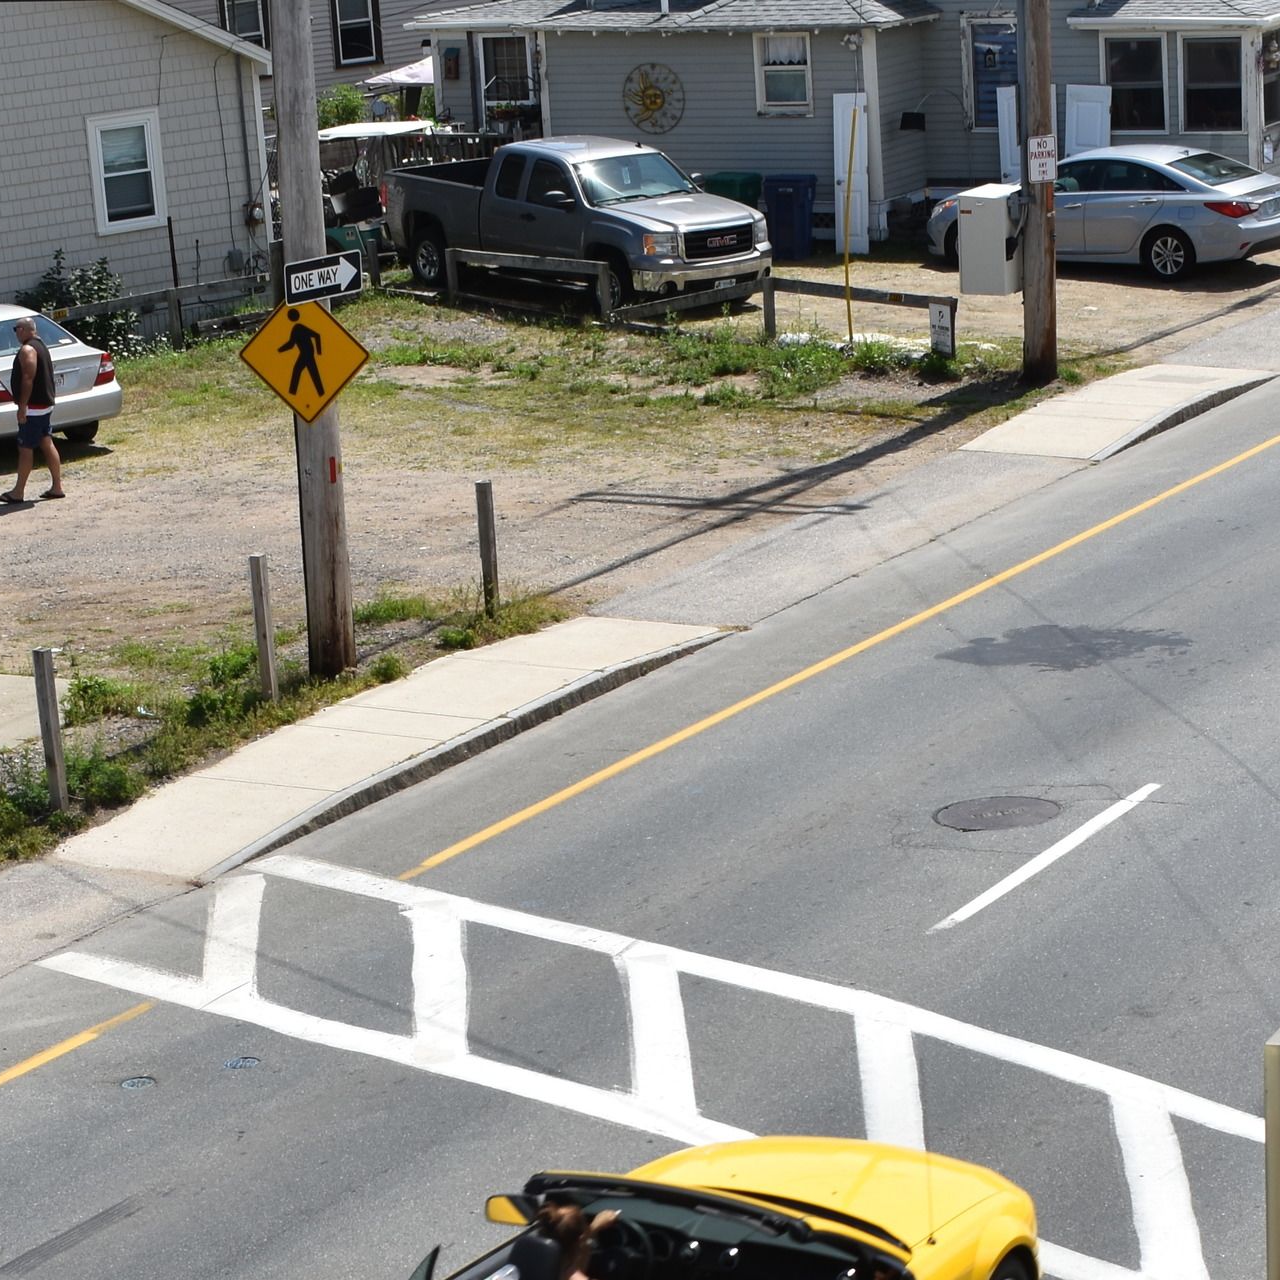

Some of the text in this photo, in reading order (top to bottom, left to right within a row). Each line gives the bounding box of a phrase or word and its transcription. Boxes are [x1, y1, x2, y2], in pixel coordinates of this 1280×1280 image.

[1037, 140, 1048, 149] NO
[1030, 150, 1055, 160] PARKING
[706, 234, 738, 249] GMC
[293, 267, 340, 291] ONE WAY
